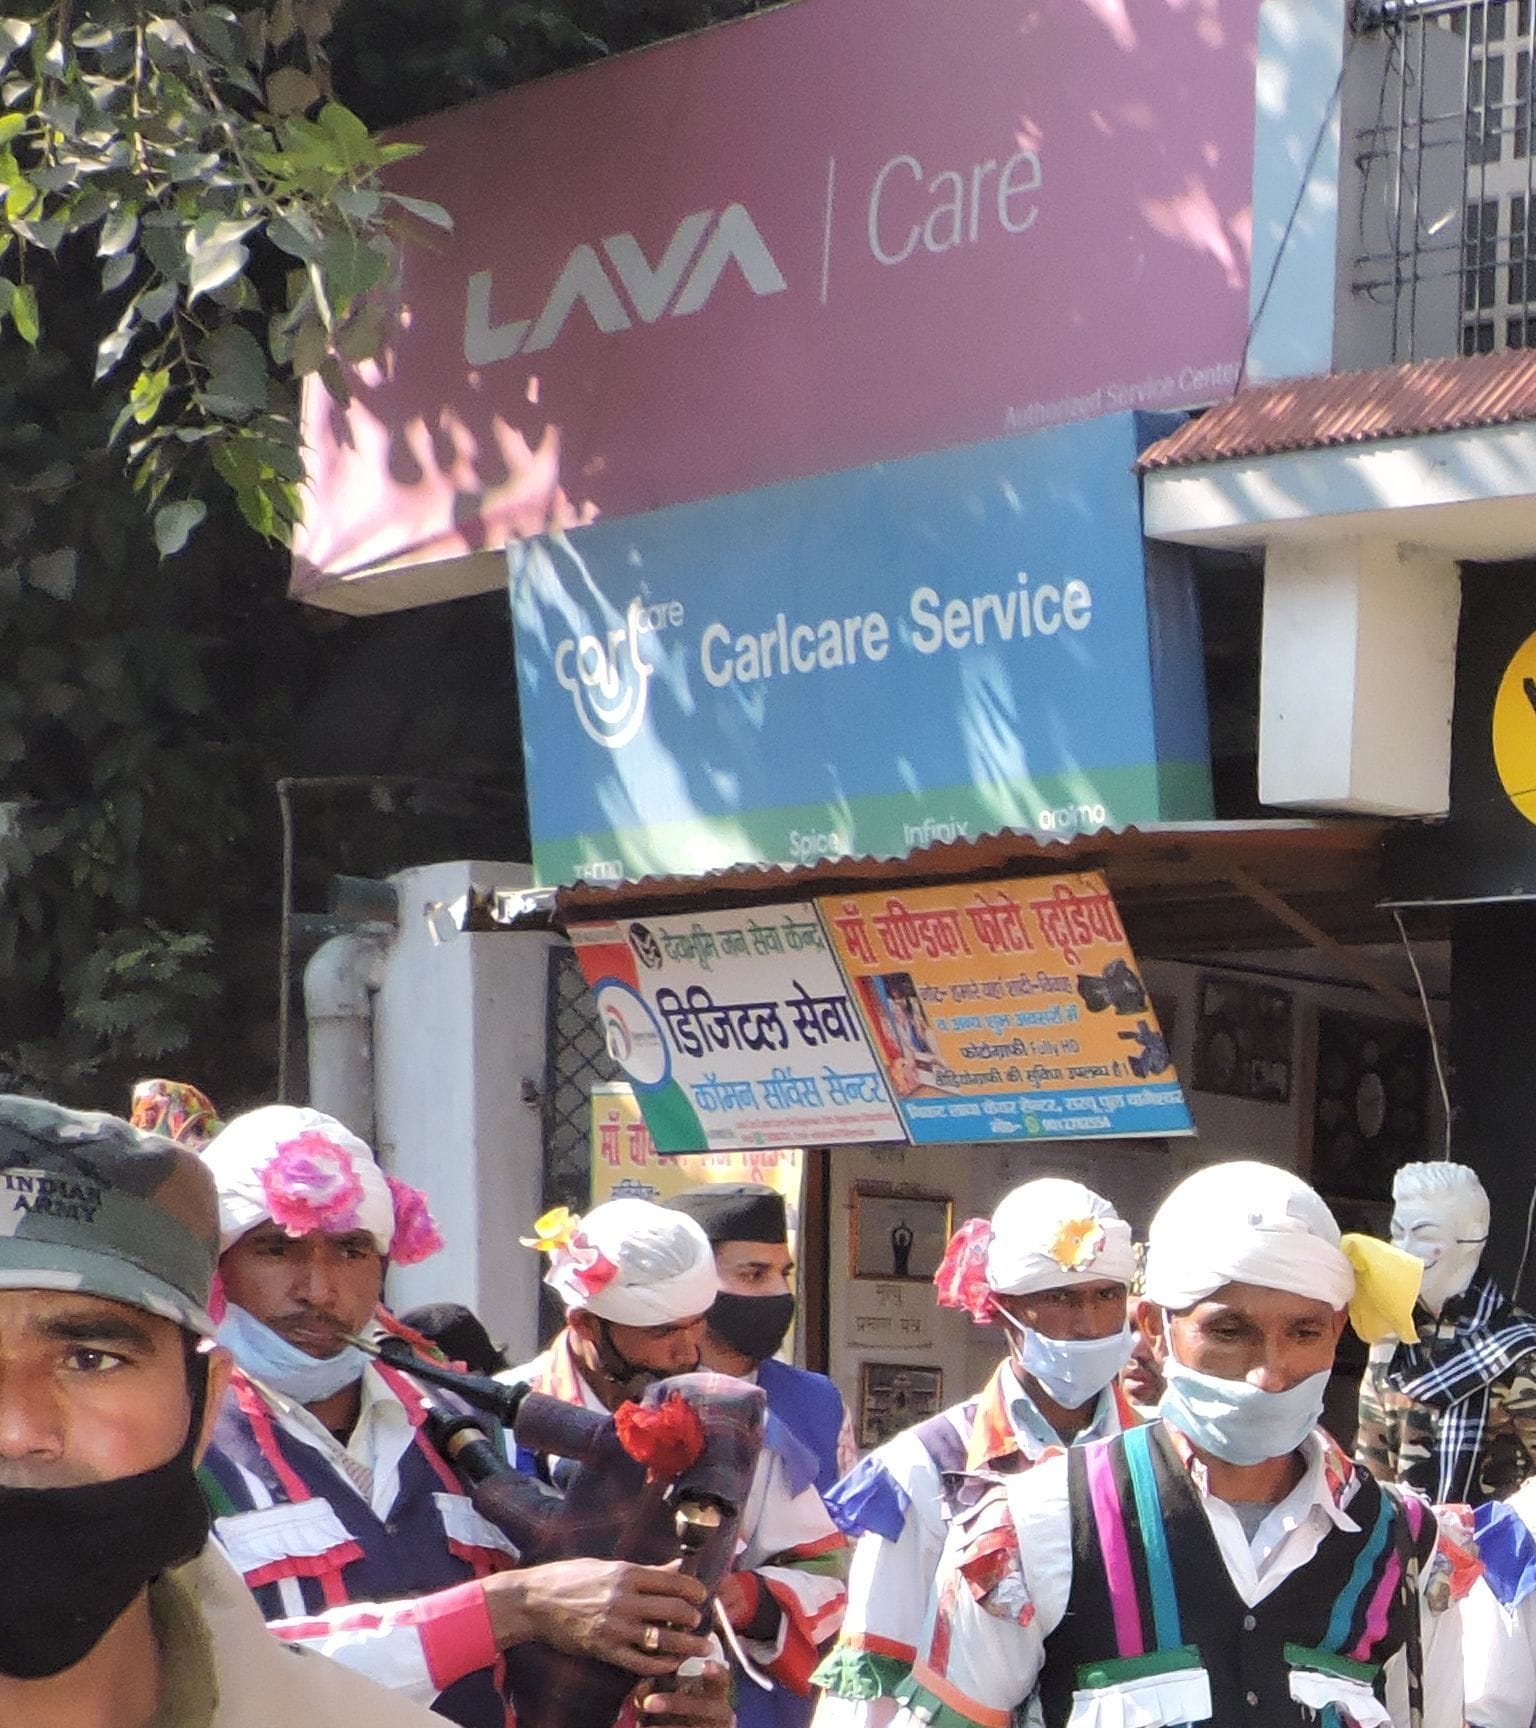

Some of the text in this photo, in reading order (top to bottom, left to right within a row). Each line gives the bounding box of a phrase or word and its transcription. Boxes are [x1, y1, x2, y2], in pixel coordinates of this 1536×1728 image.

[464, 148, 1042, 366] LAVA Care
[1105, 375, 1176, 403] Service
[701, 571, 1093, 687] Carlcare Service
[789, 829, 840, 861] Spice
[715, 929, 750, 957] जन
[748, 918, 784, 954] सेवा
[965, 889, 1035, 955] फोटो
[655, 978, 861, 1058] डिजिटल सेवा
[689, 1071, 760, 1113] कॉमन
[756, 1065, 825, 1110] सर्विस
